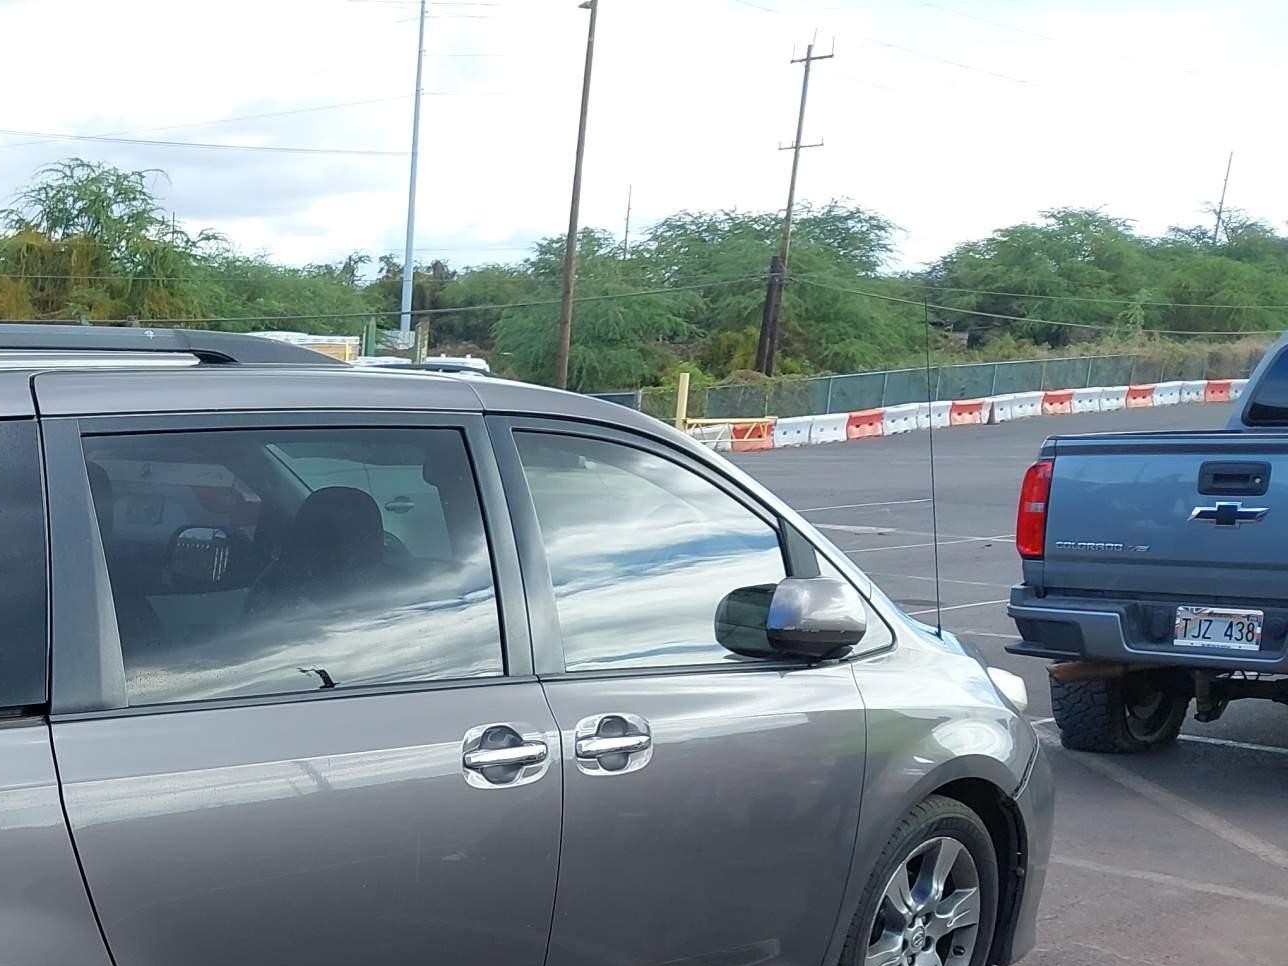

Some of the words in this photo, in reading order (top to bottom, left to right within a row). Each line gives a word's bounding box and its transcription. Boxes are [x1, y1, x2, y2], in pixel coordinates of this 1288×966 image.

[1055, 541, 1123, 552] COLORADO
[1182, 618, 1213, 640] TJZ
[1224, 620, 1255, 642] 438
